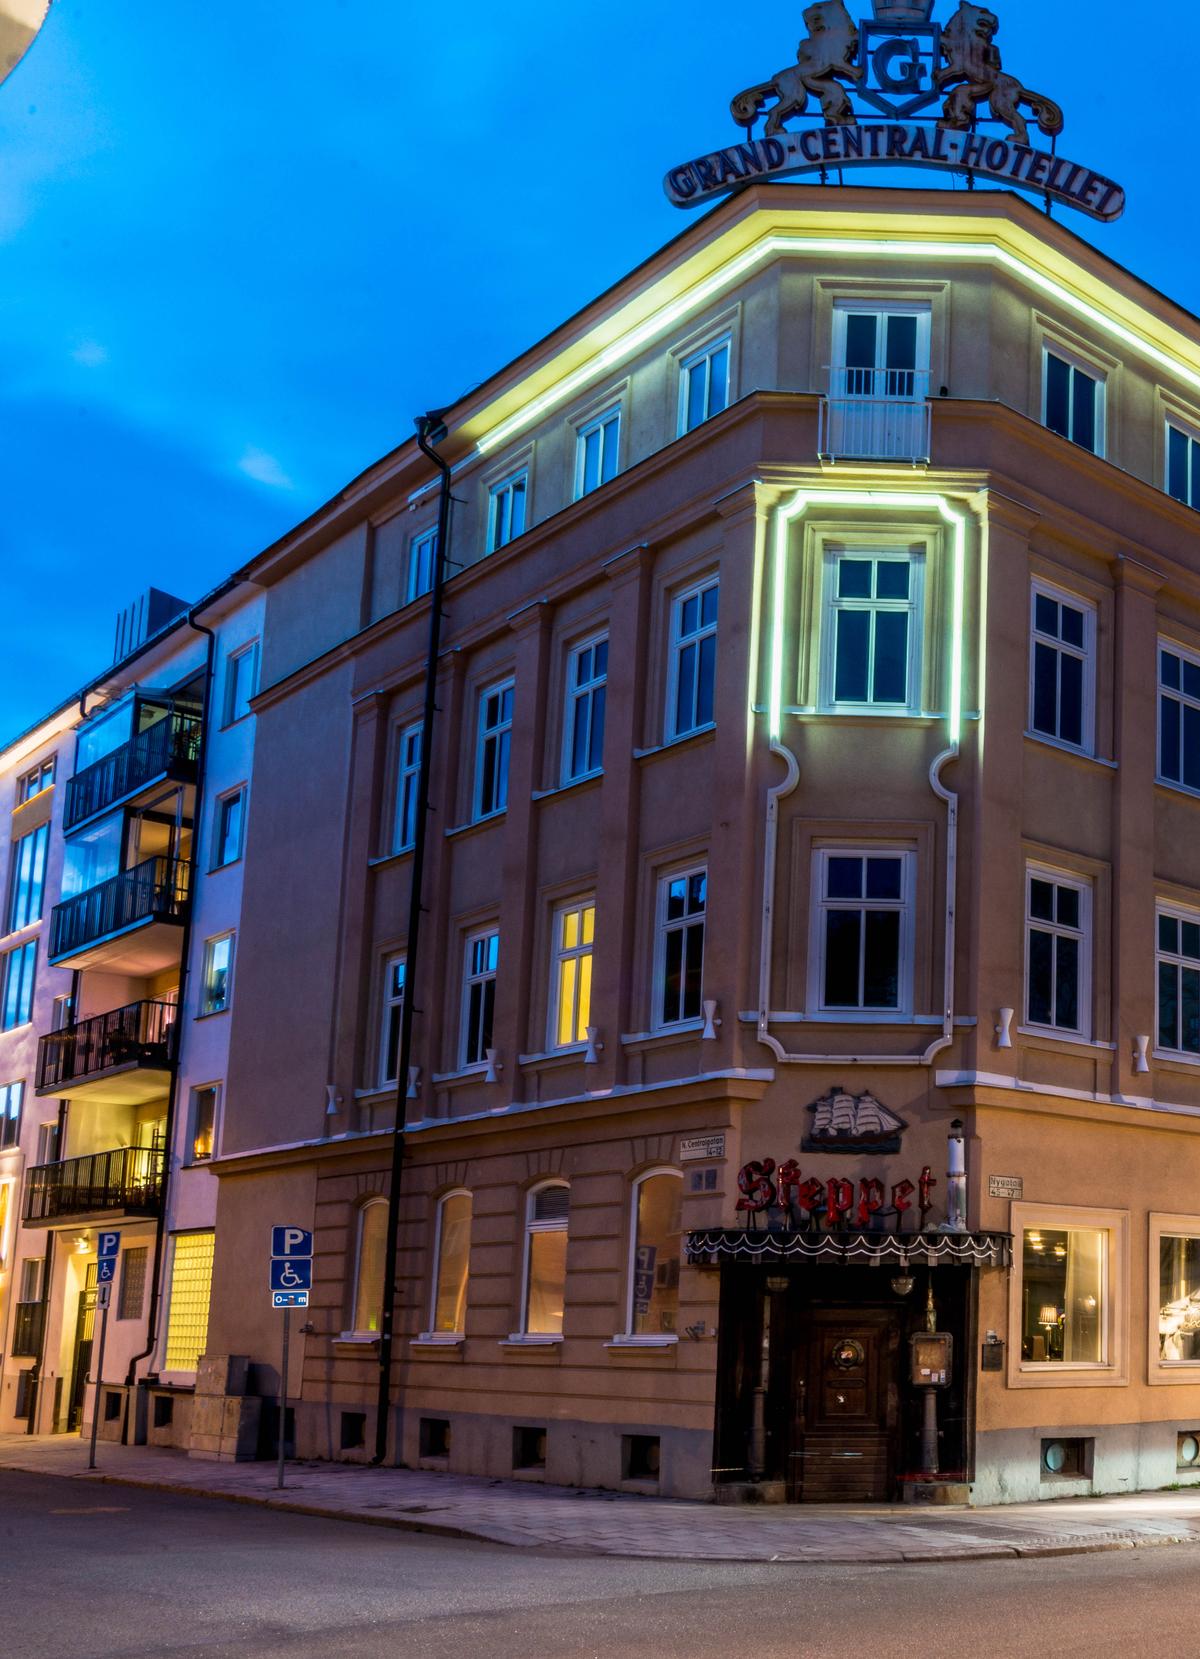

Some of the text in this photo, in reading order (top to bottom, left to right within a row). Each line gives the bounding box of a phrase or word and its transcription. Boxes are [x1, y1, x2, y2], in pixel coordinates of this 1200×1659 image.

[872, 37, 927, 95] G
[735, 1157, 937, 1228] Steppet
[103, 1234, 117, 1255] P
[284, 1228, 304, 1254] P
